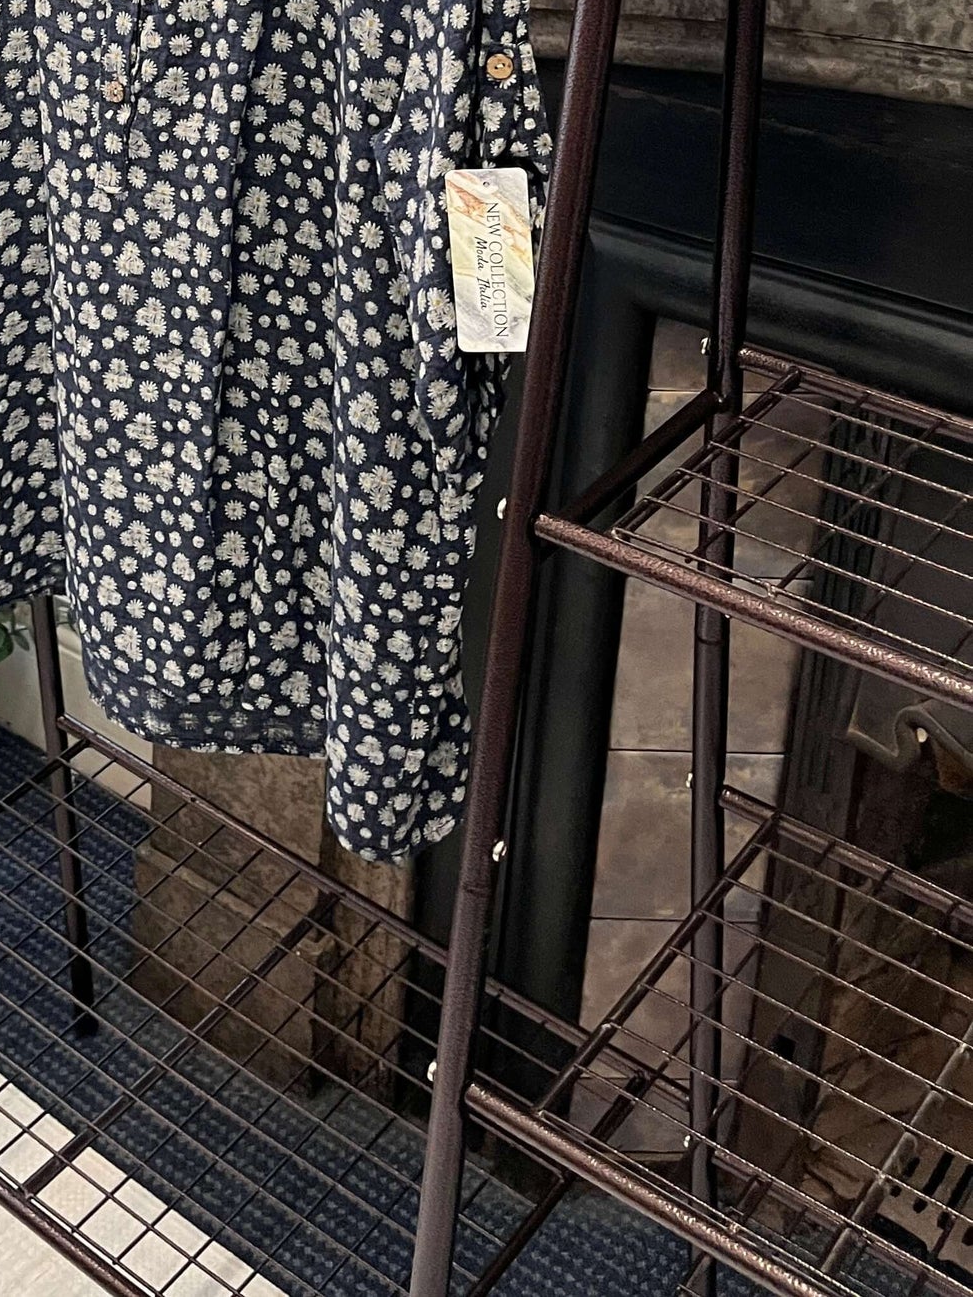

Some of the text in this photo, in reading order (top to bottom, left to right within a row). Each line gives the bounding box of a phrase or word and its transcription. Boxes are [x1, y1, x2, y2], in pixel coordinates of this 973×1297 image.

[474, 236, 491, 309] Moda Italia
[485, 202, 509, 337] NEW COLLECTION
